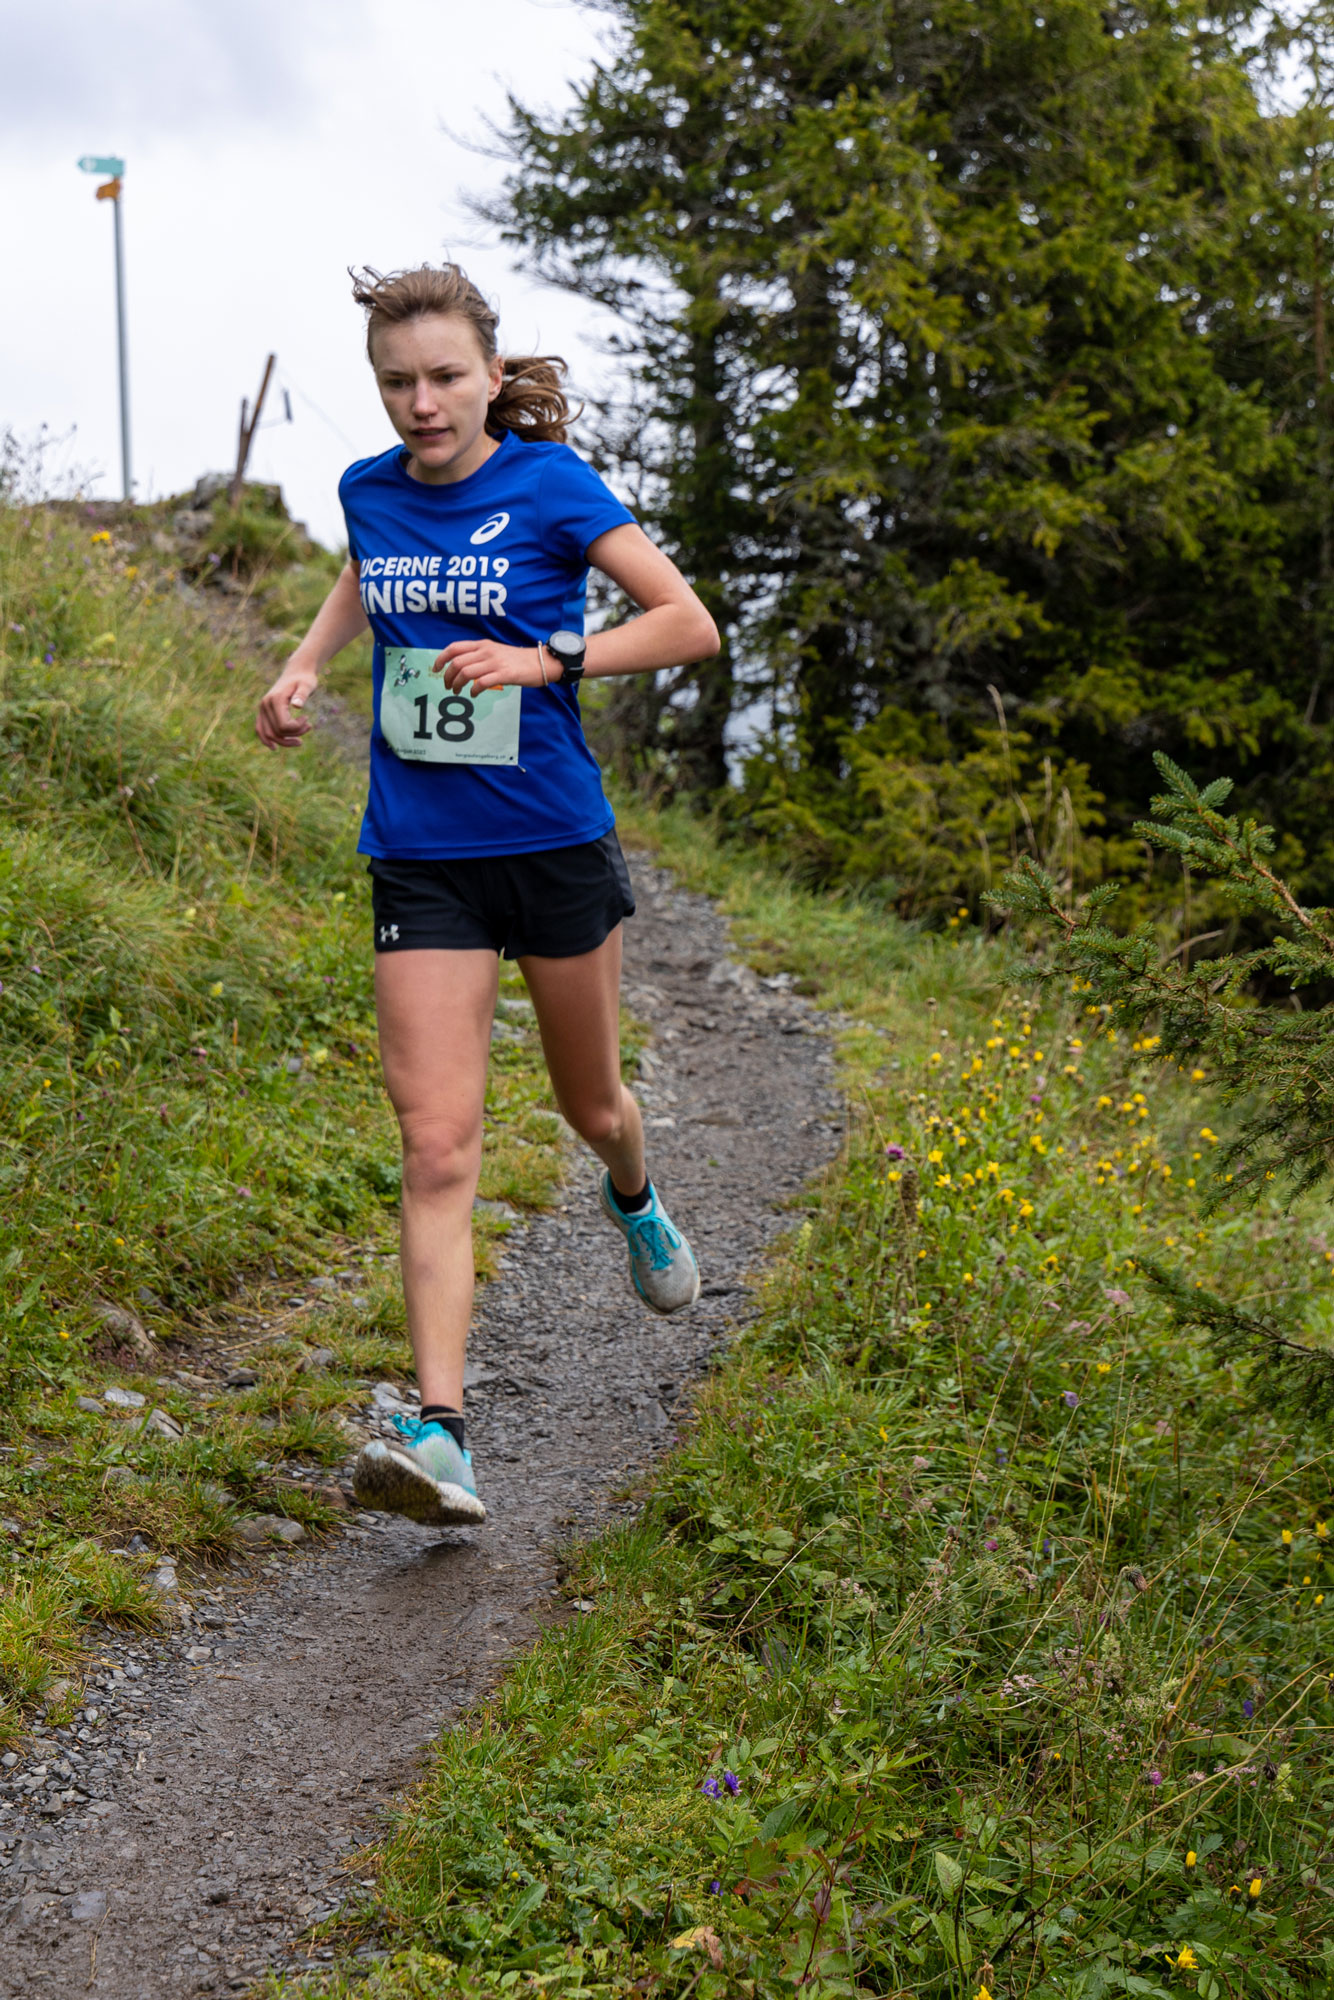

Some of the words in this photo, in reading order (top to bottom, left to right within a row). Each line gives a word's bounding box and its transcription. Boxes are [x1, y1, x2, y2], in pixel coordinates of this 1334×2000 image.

[446, 555, 510, 578] 2019
[360, 580, 508, 617] INISHER
[413, 694, 475, 742] 18
